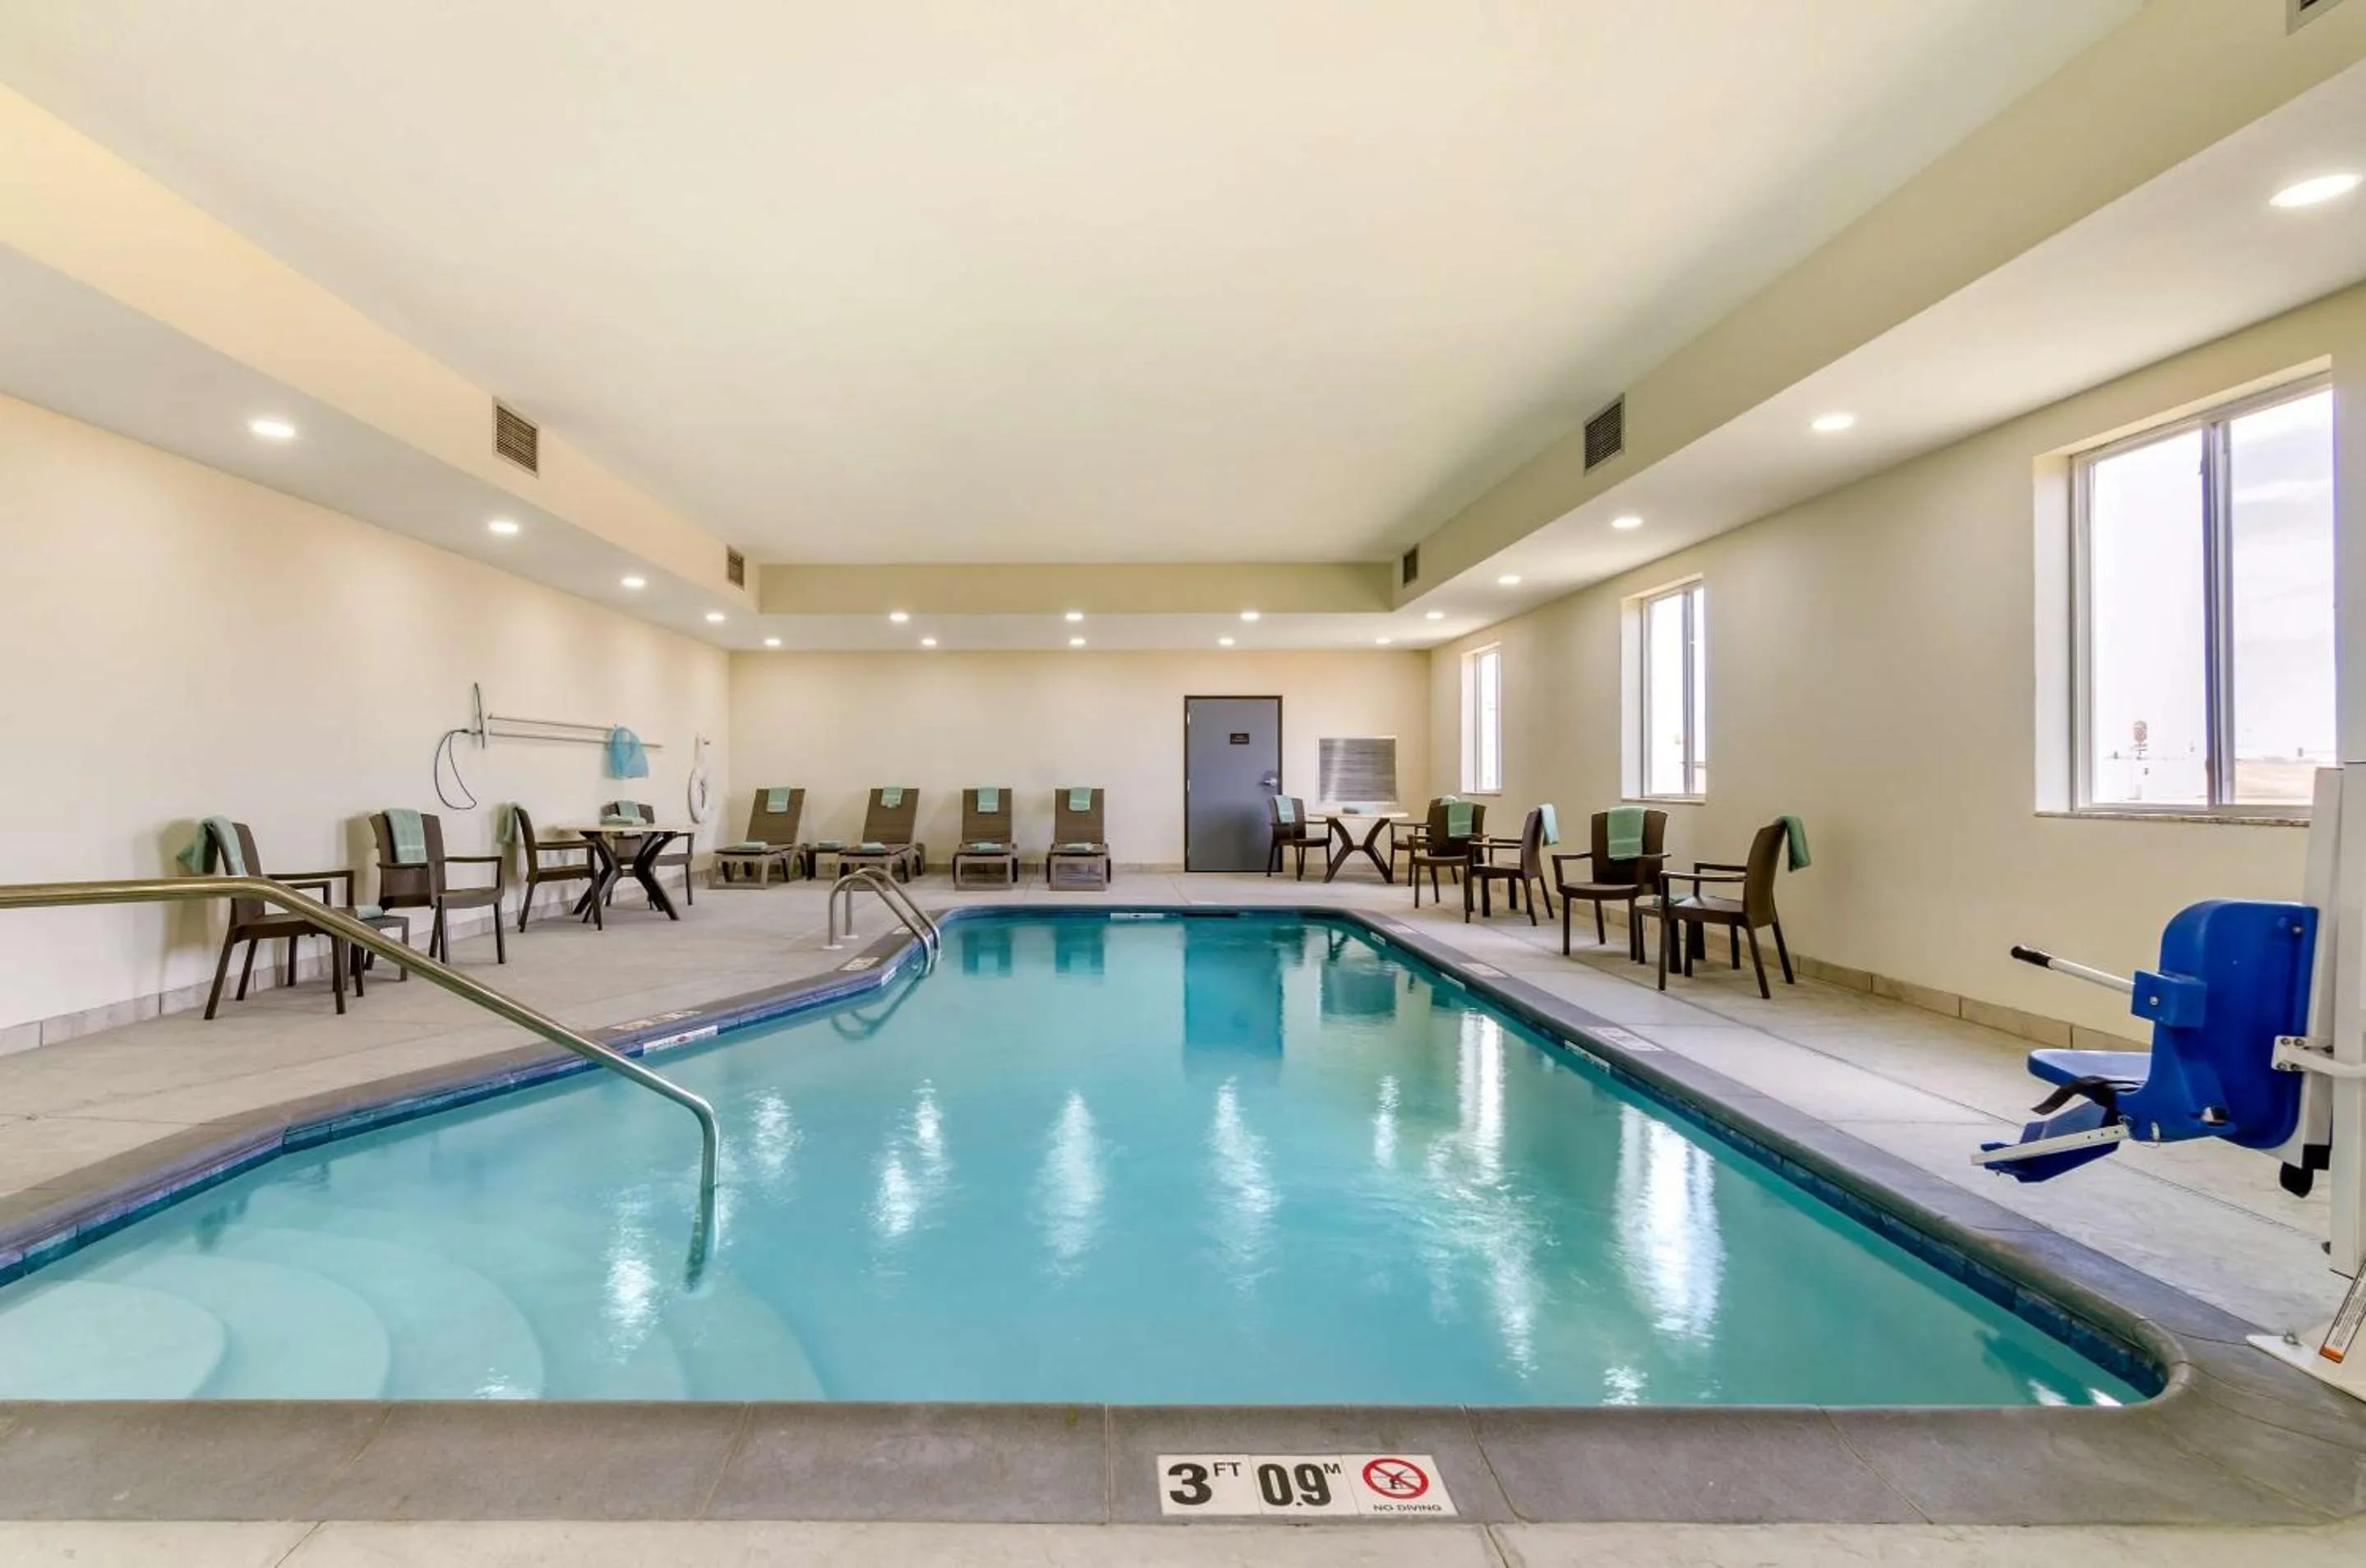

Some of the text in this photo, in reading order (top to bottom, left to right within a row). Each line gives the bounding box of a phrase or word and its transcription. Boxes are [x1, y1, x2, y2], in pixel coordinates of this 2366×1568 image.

[1168, 1462, 1241, 1506] 3 FT
[1257, 1463, 1342, 1506] 0.9 M
